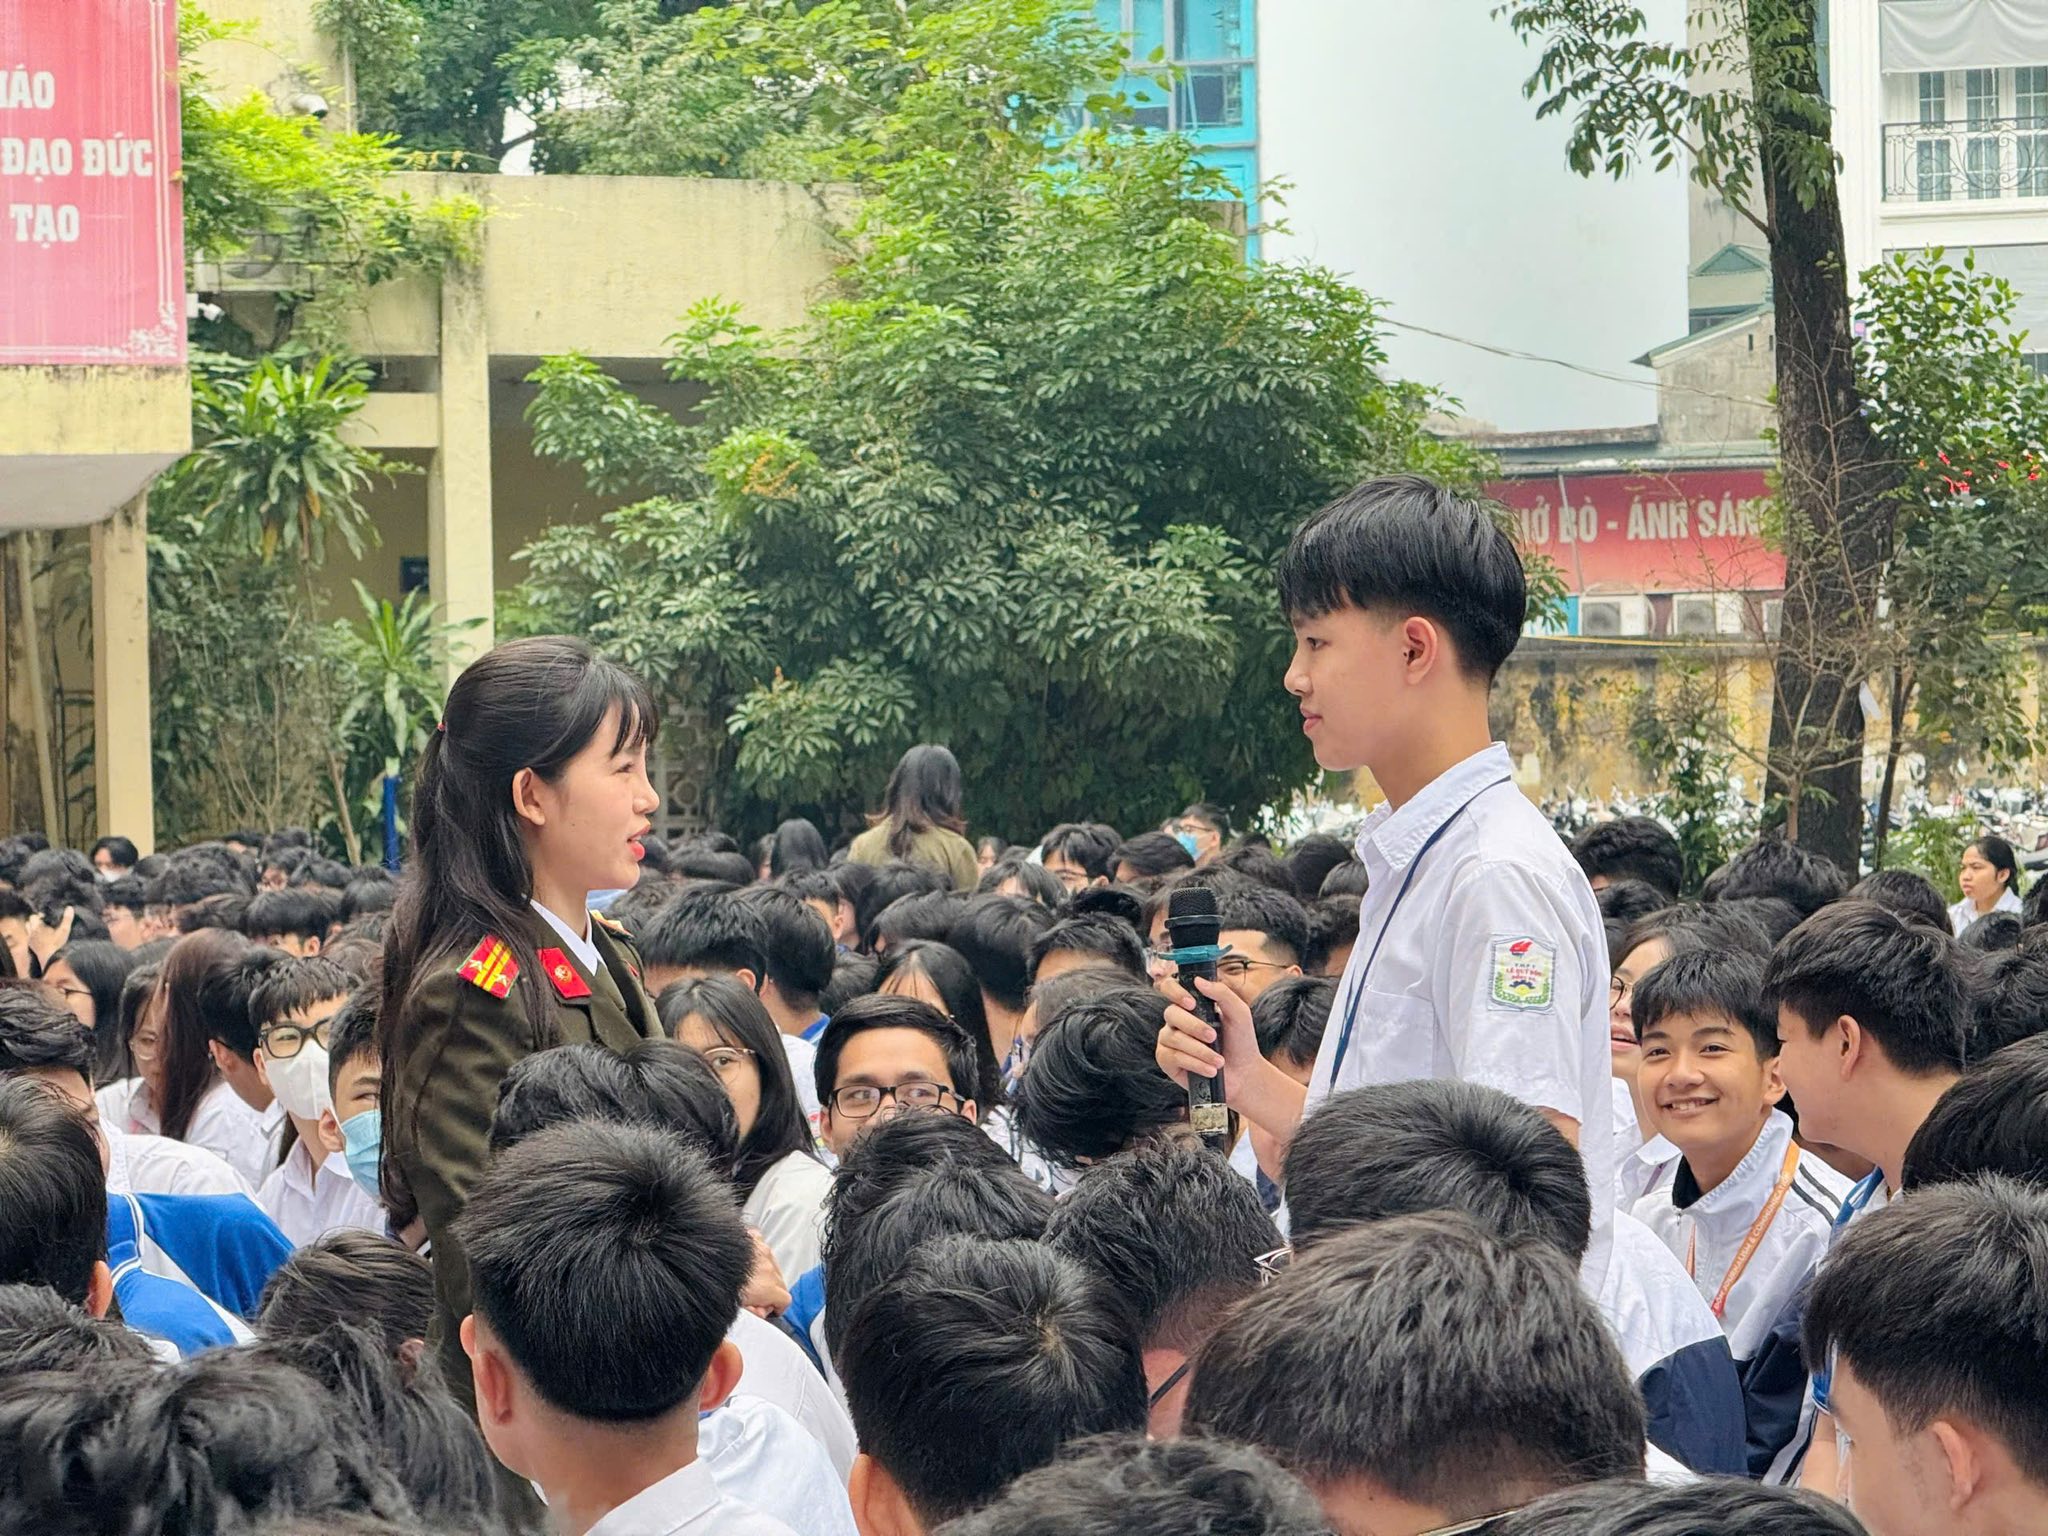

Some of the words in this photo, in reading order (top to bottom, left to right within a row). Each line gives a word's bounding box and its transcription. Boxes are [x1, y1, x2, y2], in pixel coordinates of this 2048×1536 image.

[1, 137, 73, 183] ĐẠO
[82, 131, 154, 177] ĐỨC
[9, 203, 80, 248] TẠO
[1558, 495, 1598, 543] BÒ
[1627, 496, 1689, 541] ÁNH
